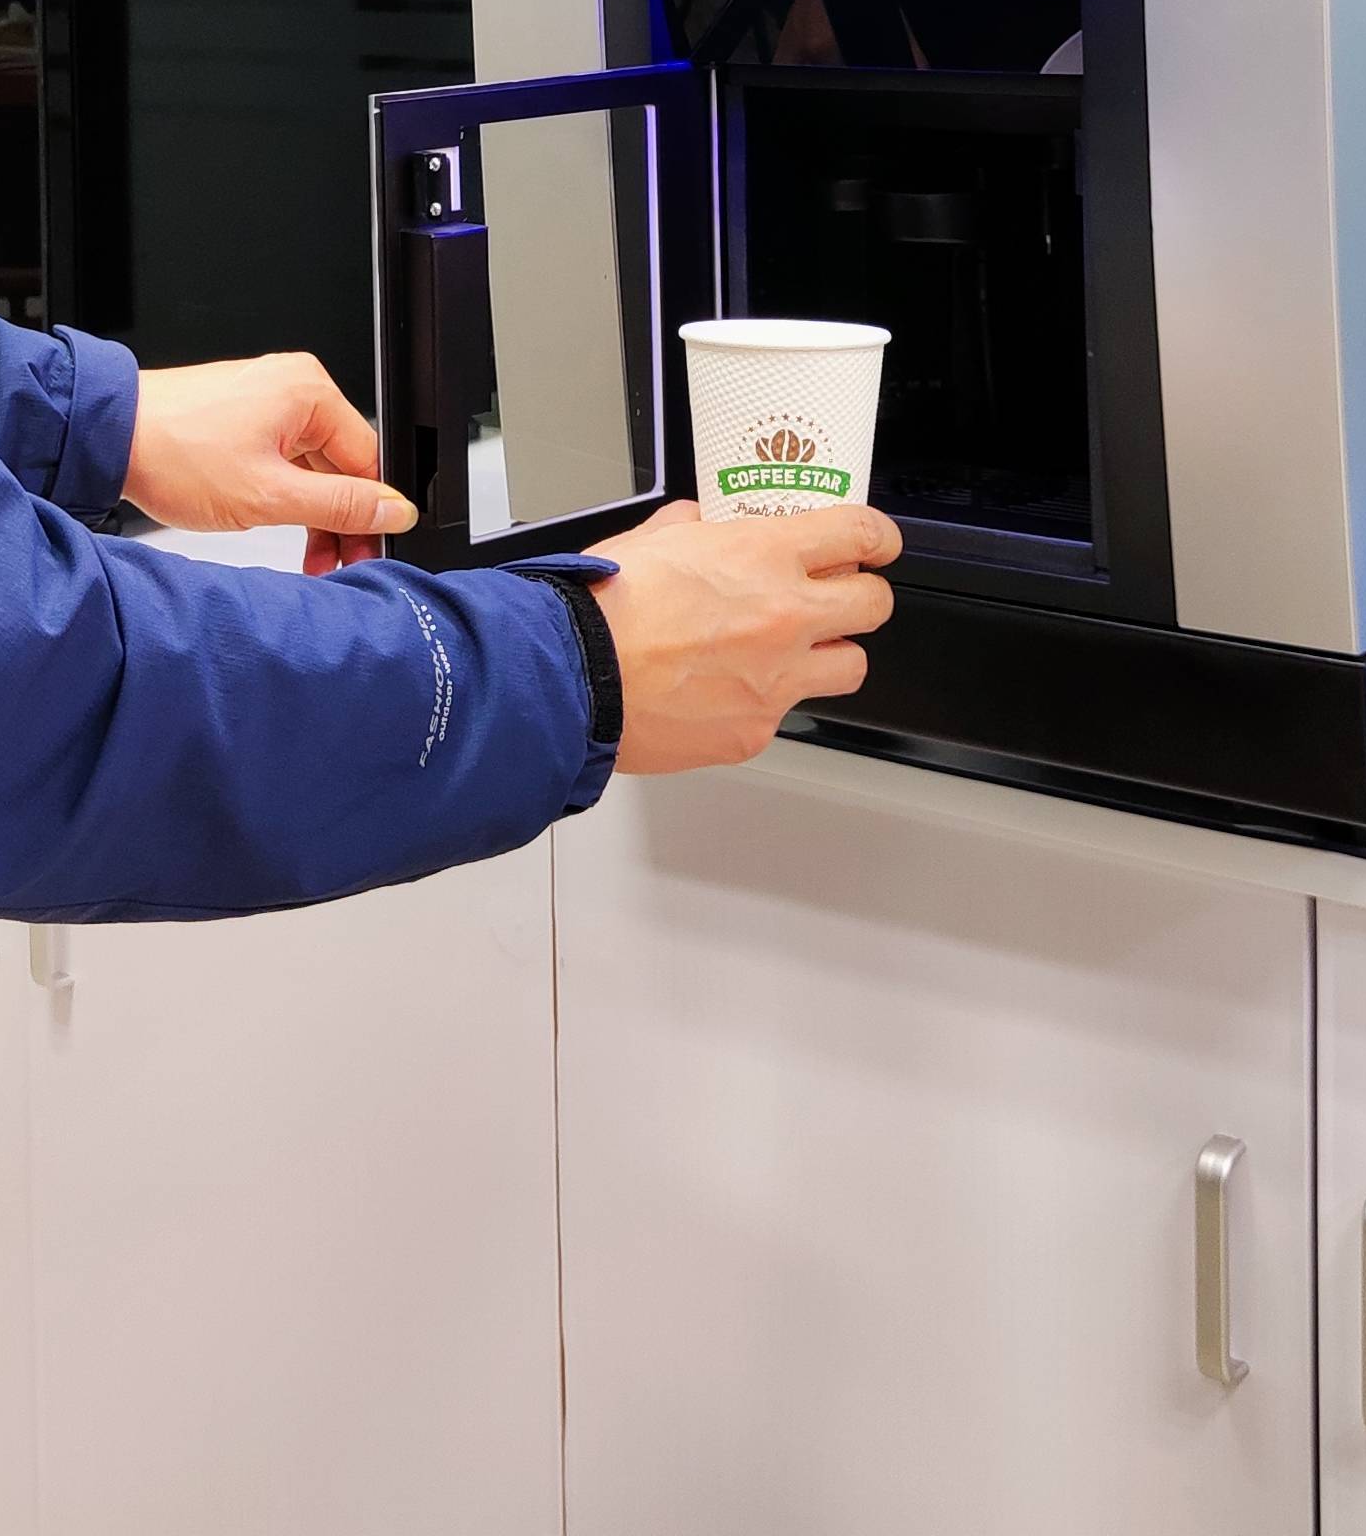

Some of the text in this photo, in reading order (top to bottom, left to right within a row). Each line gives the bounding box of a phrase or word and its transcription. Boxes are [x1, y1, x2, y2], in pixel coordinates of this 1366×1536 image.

[727, 467, 843, 493] COFFEE STAR
[732, 502, 773, 517] Fresh
[419, 648, 445, 768] FASHION
[435, 638, 453, 742] outdoor wear
